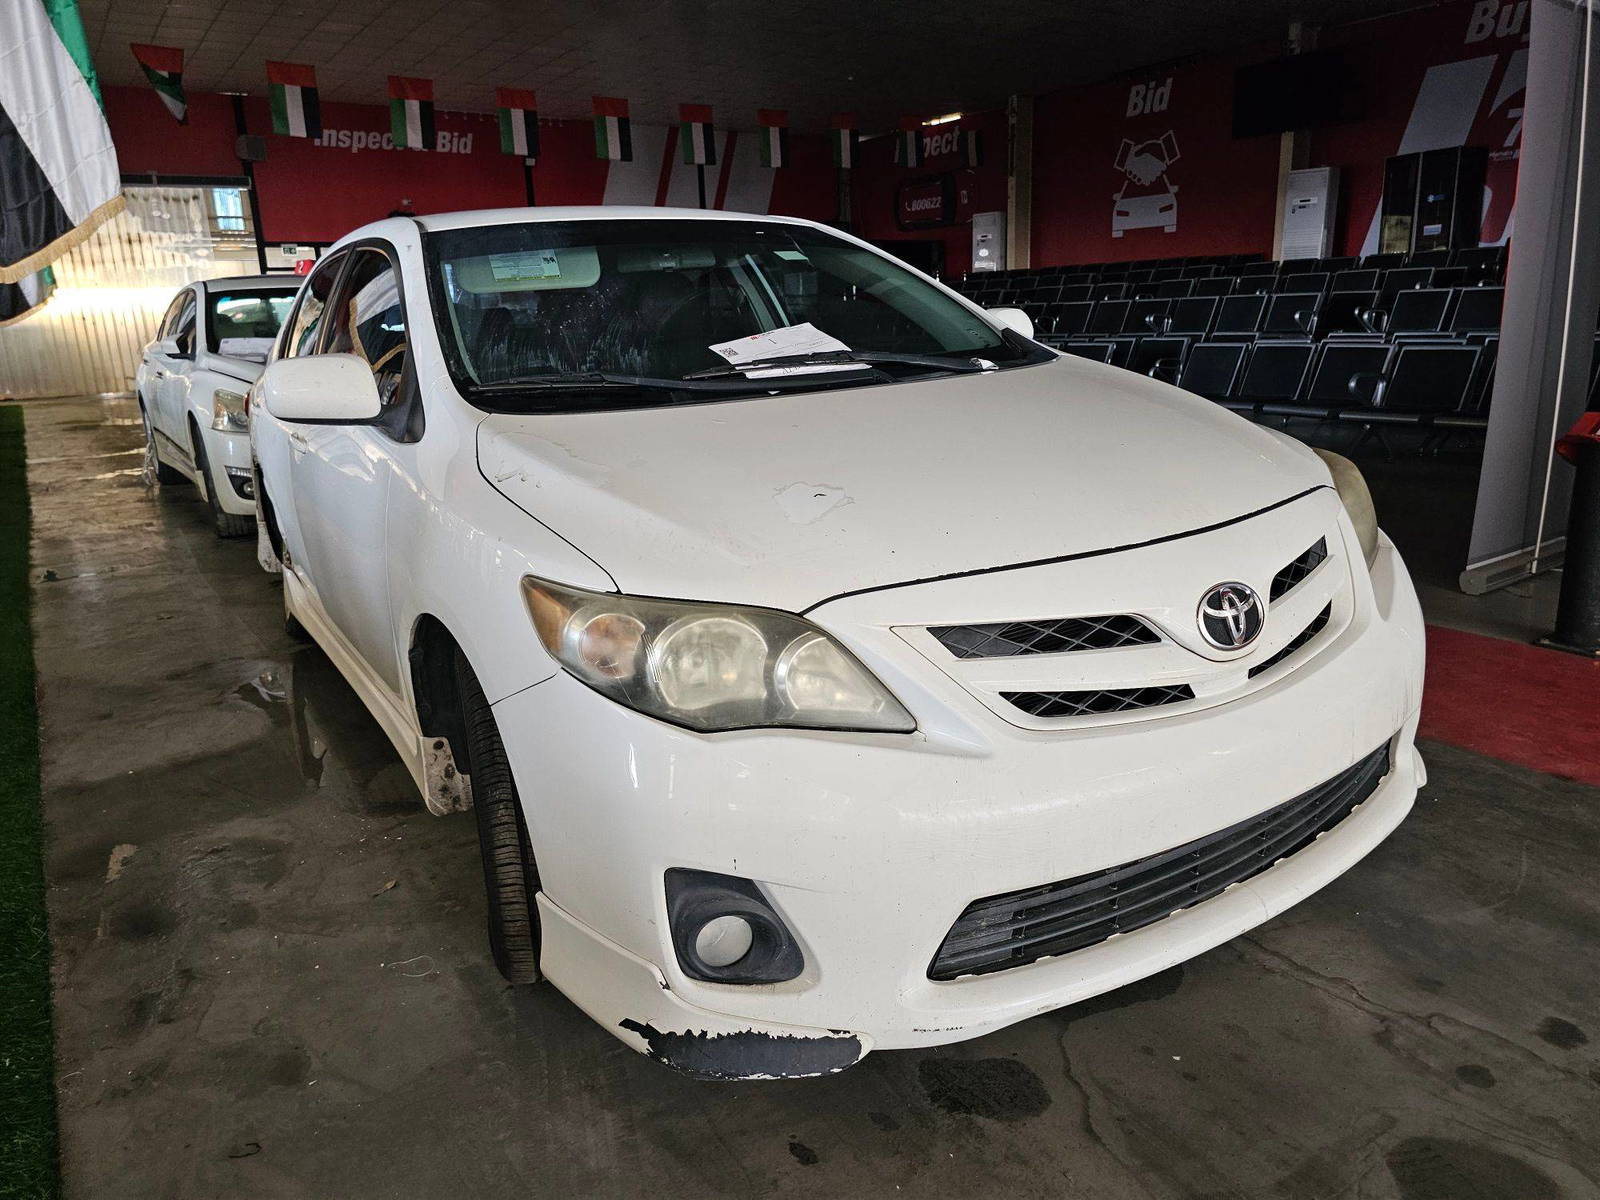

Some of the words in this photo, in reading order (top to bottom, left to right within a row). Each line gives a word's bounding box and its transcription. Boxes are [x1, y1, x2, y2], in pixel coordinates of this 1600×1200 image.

[1464, 1, 1529, 43] Bu
[1126, 78, 1173, 117] Bid
[314, 129, 405, 152] nspec
[436, 131, 473, 154] Bid
